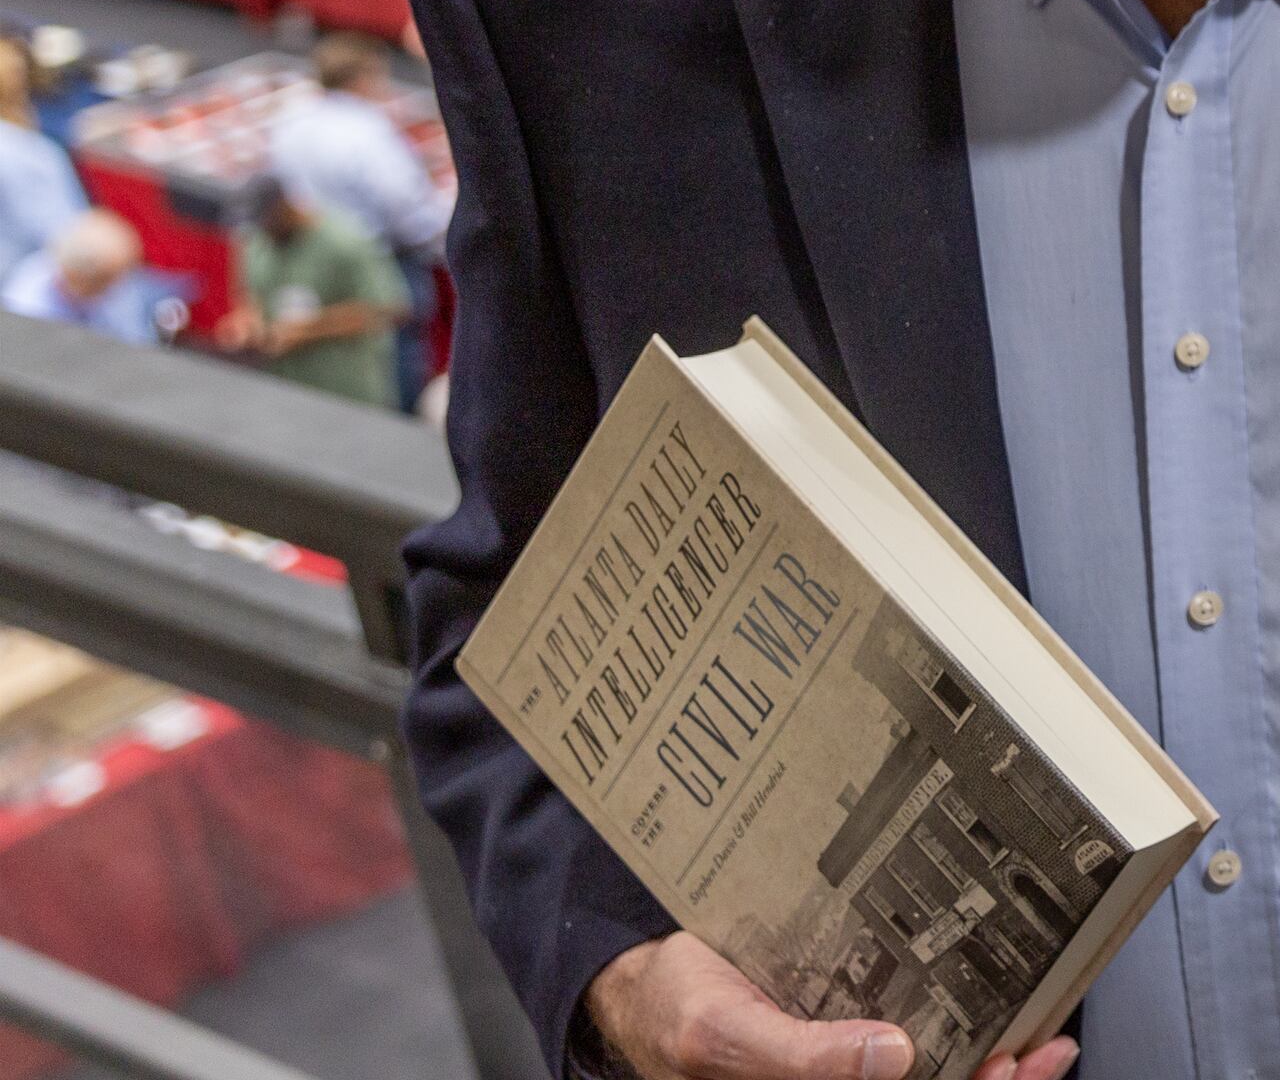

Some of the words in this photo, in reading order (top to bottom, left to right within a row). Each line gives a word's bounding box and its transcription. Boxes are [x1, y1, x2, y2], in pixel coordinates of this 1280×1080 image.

[520, 685, 542, 715] THE
[537, 531, 646, 706] ATLANTA
[624, 420, 707, 556] DAILY
[561, 472, 762, 786] INTELLIGENCER
[641, 820, 664, 848] THE
[656, 654, 775, 808] CIVIL
[732, 552, 841, 680] WAR
[631, 783, 667, 836] COVERS
[689, 866, 718, 906] Stephen
[712, 838, 738, 870] Davis
[732, 823, 745, 839] &
[740, 801, 759, 829] Bill
[754, 760, 787, 809] Hendrick
